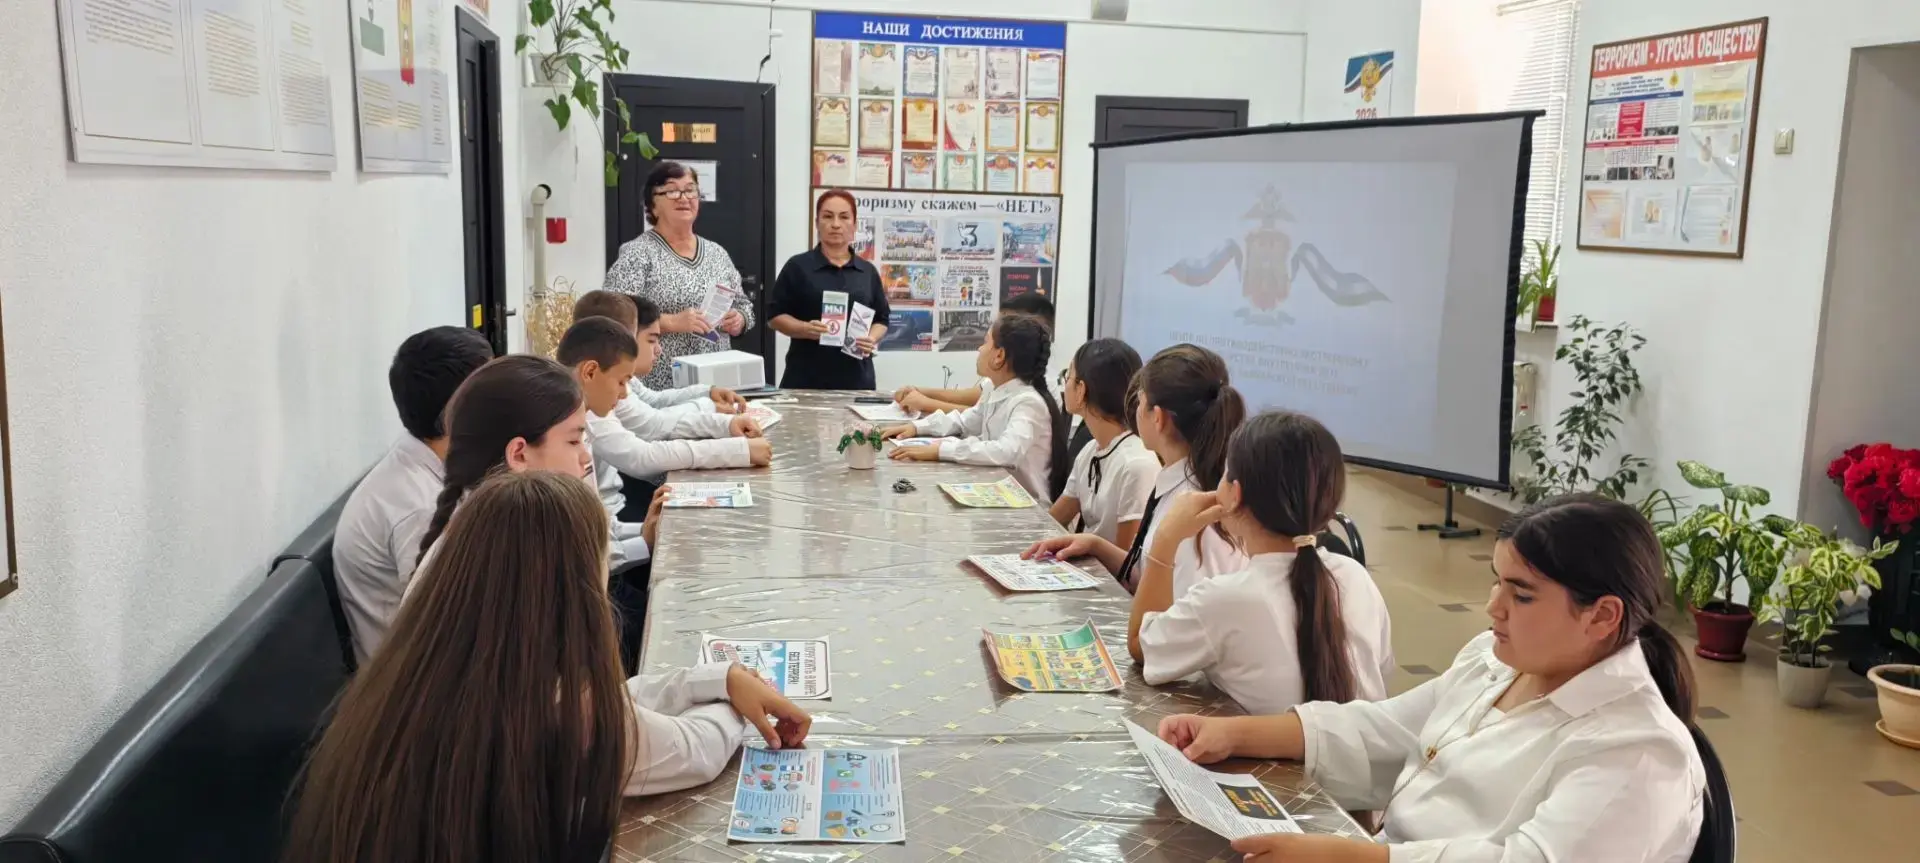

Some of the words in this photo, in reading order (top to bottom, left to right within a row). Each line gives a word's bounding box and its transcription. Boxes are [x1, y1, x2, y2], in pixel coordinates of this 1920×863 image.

[862, 21, 910, 36] НАШИ
[921, 24, 1024, 40] ДОСТИЖЕНИЯ
[1594, 41, 1649, 72] ТЕРРОРИЗМ
[1655, 34, 1695, 64] УГРОЗА
[1697, 23, 1762, 61] ОБЩЕСТВУ
[921, 197, 977, 212] скажем
[824, 304, 844, 315] МЫ
